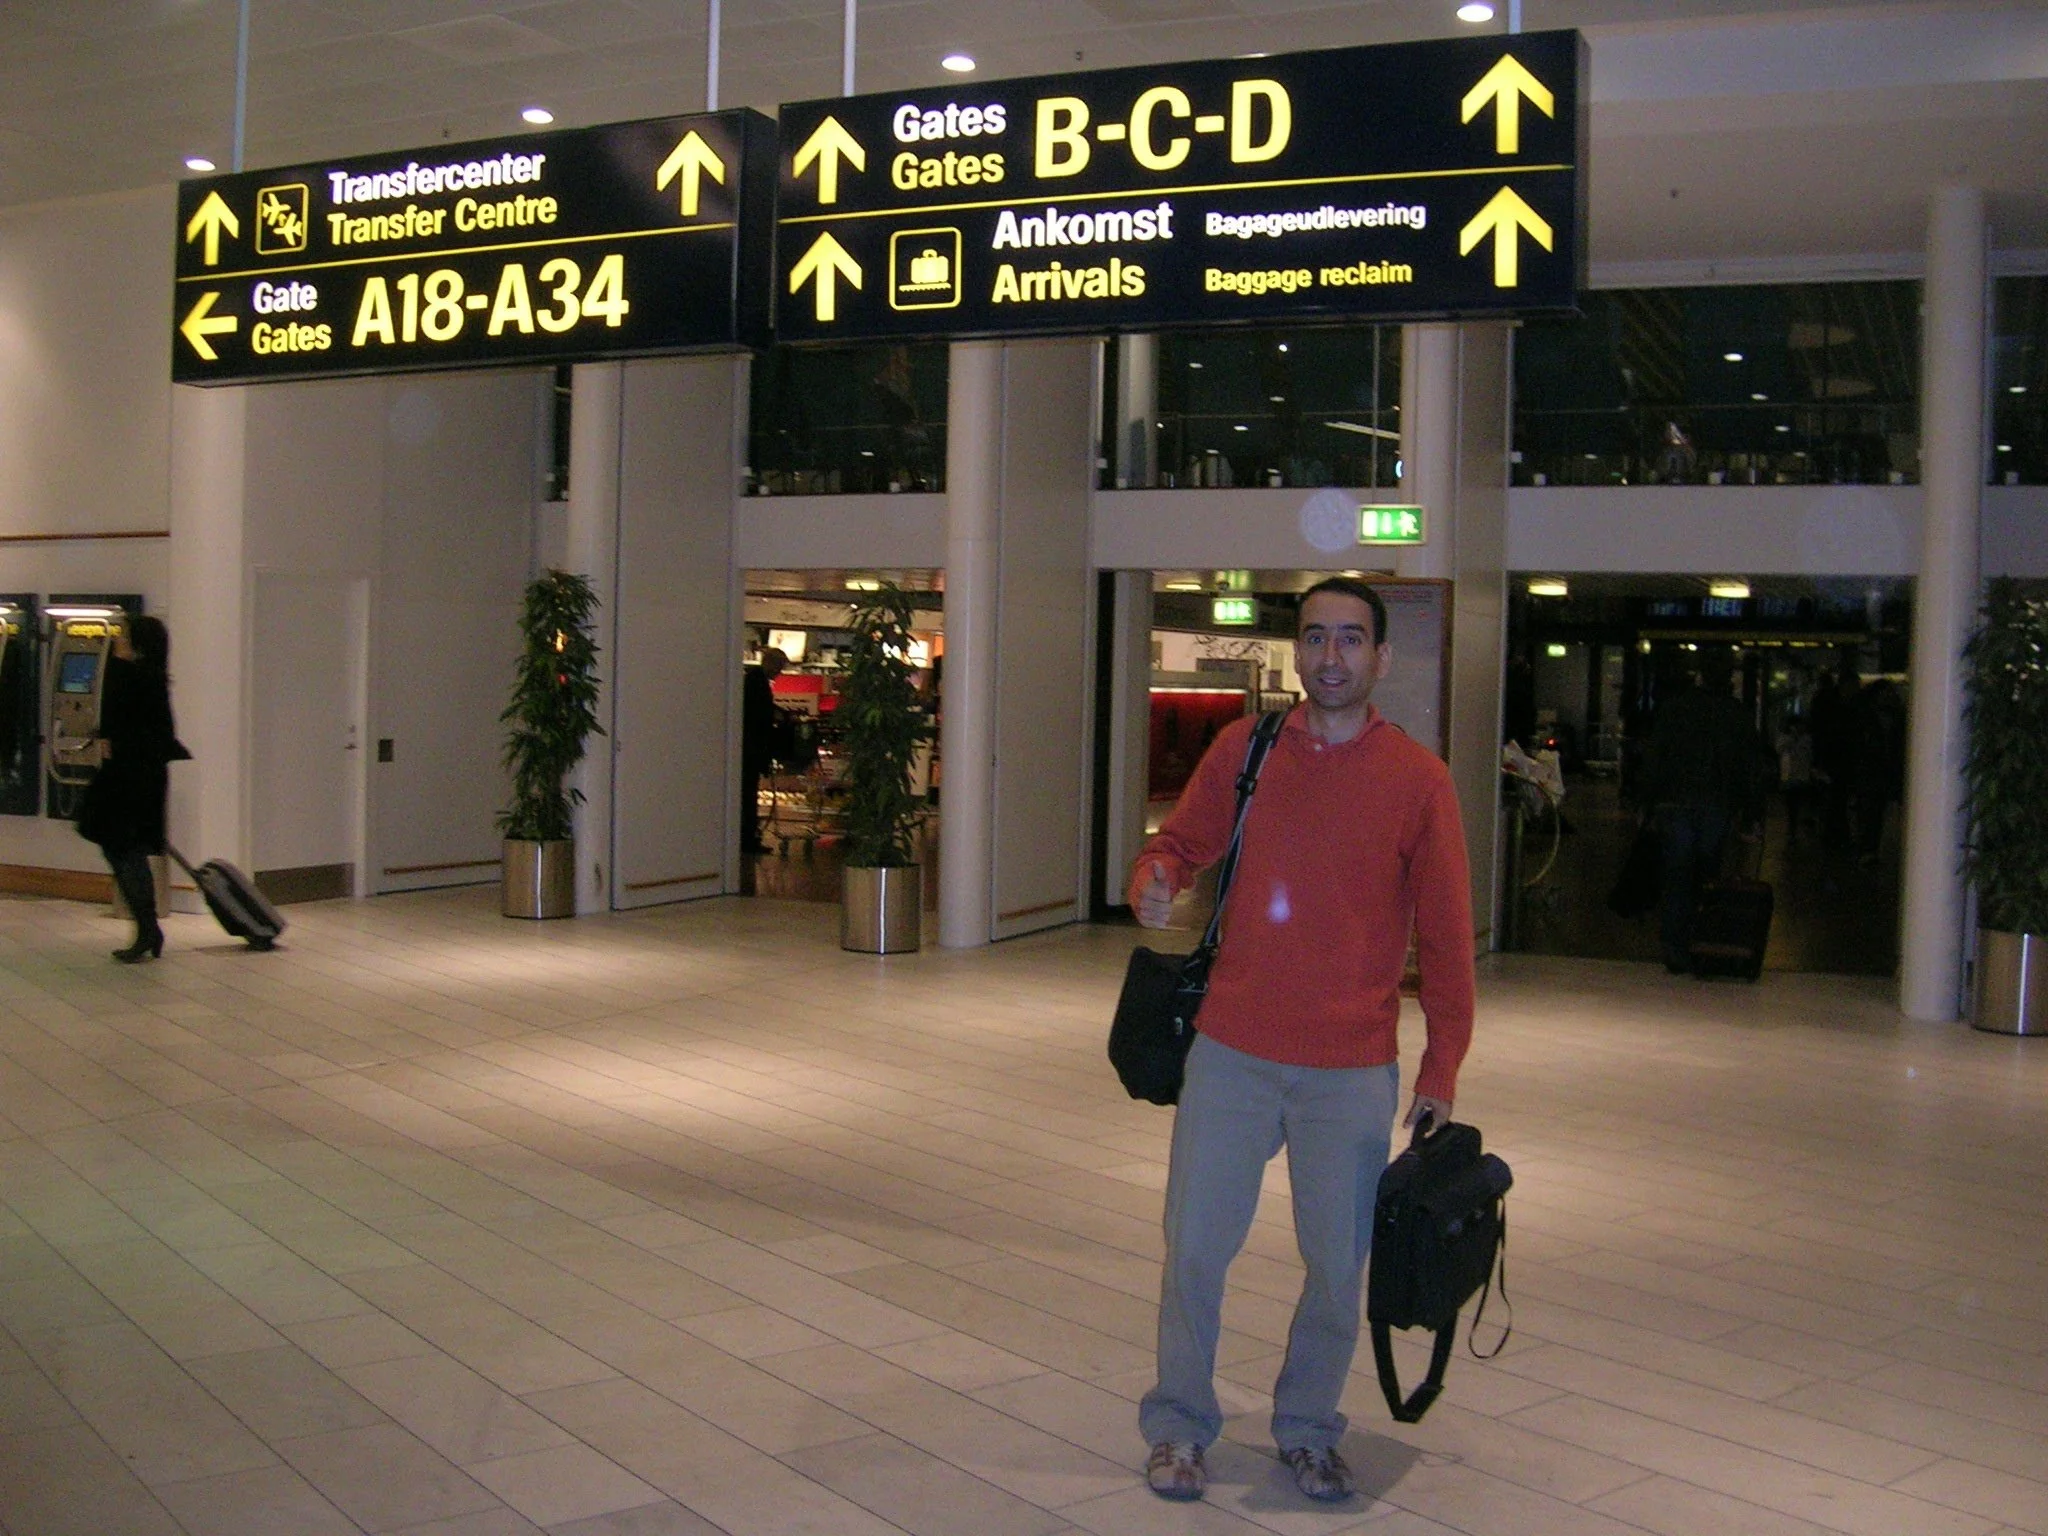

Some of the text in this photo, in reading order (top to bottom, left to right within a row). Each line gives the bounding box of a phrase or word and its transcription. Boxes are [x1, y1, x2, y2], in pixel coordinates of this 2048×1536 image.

[892, 103, 1007, 145] Gates
[1034, 79, 1292, 179] B-C-D
[327, 152, 546, 205] Transfercenter
[890, 150, 1005, 191] Gates
[326, 193, 558, 246] Transfer Centre
[991, 200, 1174, 250] Ankomst
[1204, 201, 1428, 240] Bagageudlevering
[252, 281, 318, 315] Gate
[351, 253, 631, 347] A18-A34
[991, 257, 1146, 304] Arrivals
[1204, 261, 1414, 296] Baggage reclaim
[251, 321, 332, 355] Gates
